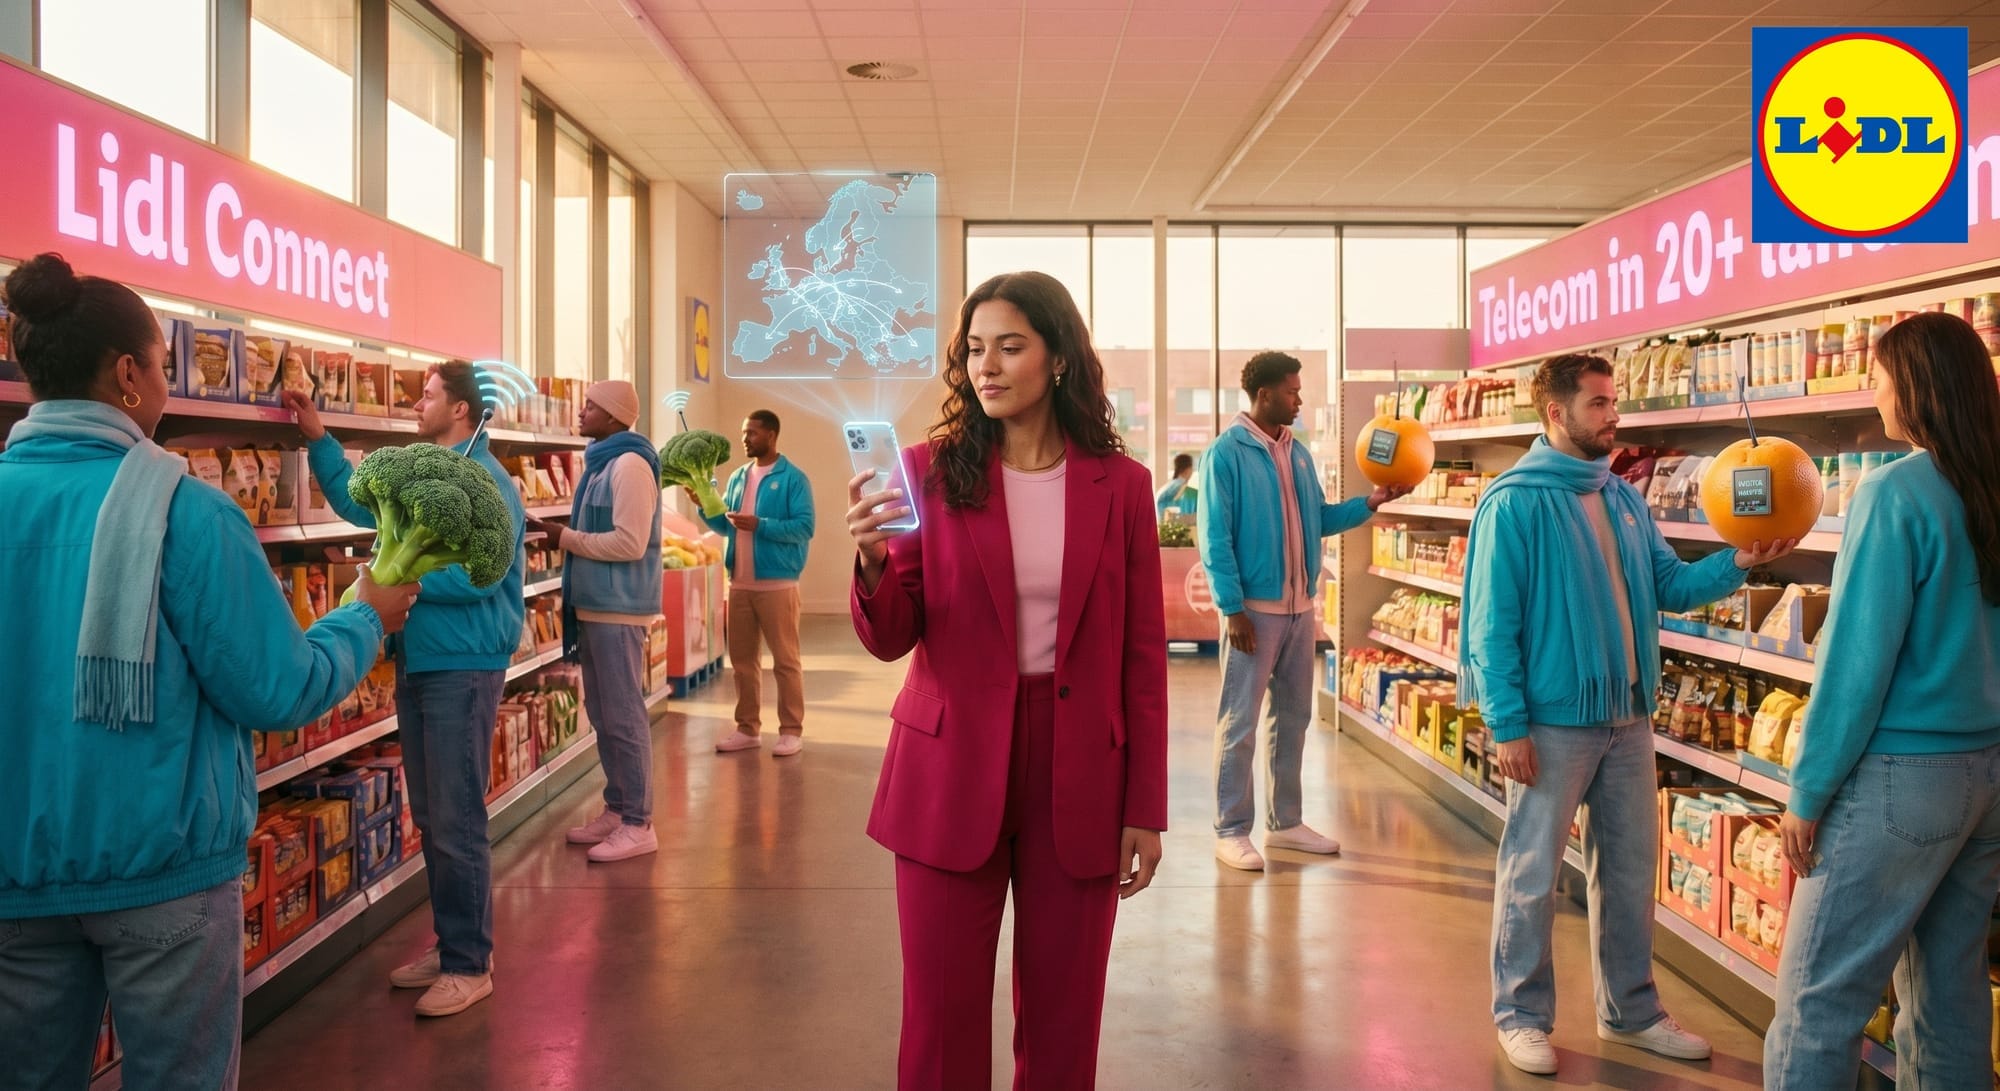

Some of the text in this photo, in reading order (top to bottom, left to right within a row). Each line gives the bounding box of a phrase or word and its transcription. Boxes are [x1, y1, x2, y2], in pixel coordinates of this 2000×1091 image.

[57, 123, 390, 319] Lidl Connect
[1478, 210, 1744, 347] Telecom in 20+
